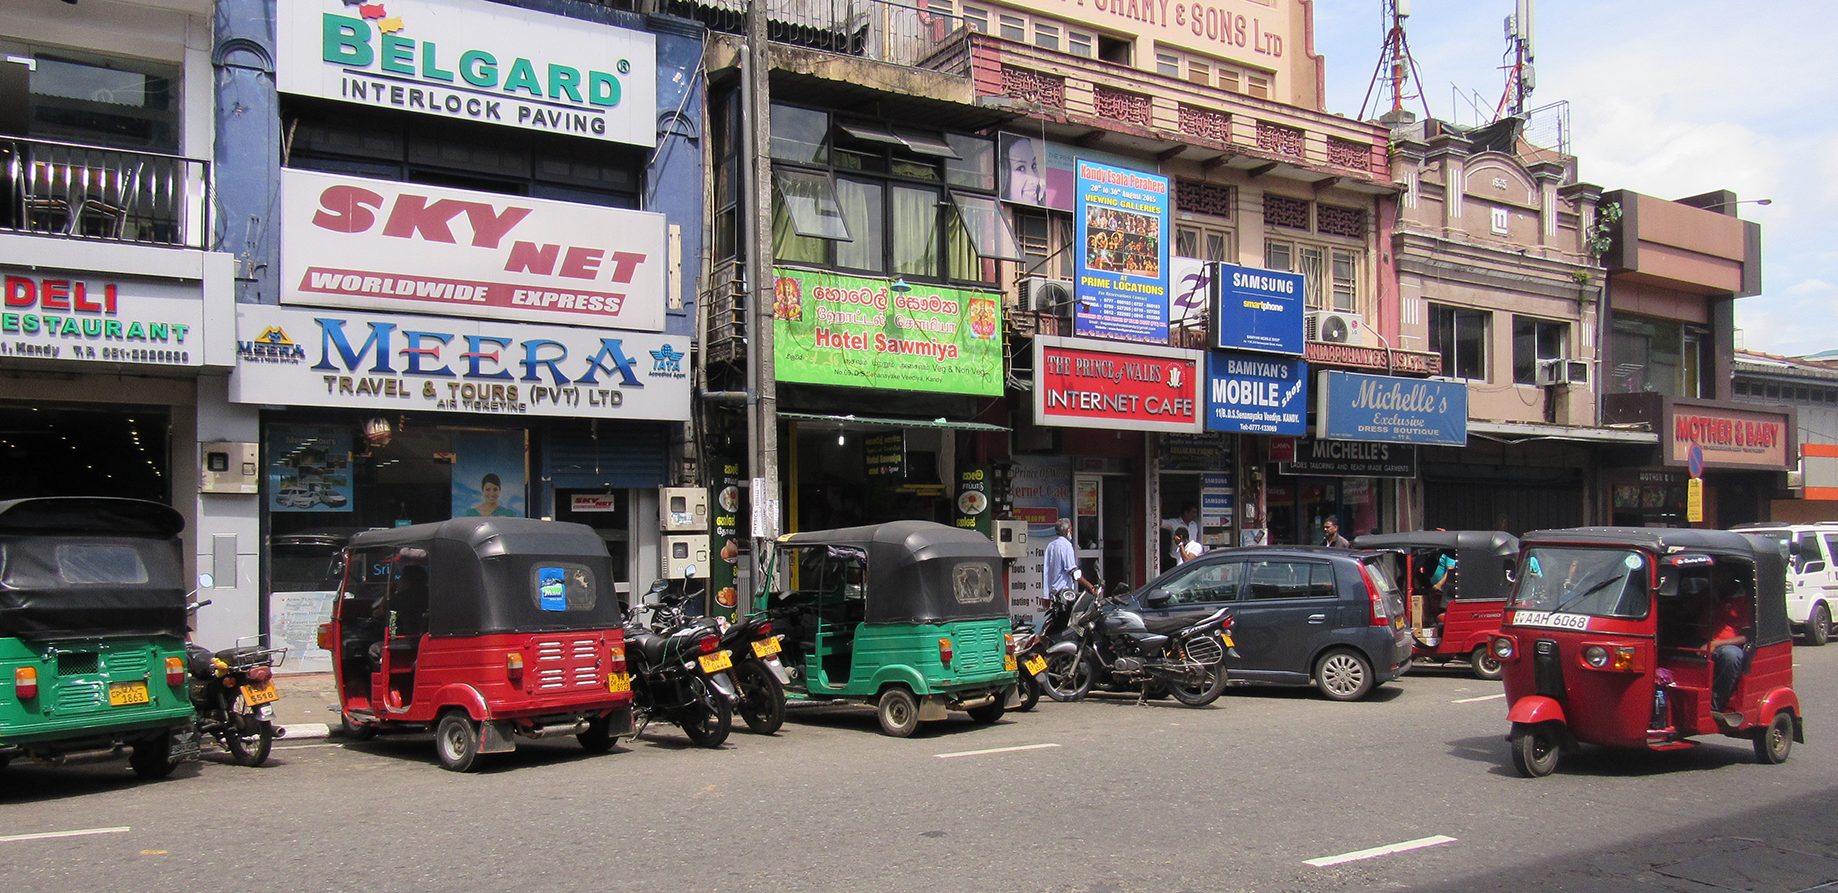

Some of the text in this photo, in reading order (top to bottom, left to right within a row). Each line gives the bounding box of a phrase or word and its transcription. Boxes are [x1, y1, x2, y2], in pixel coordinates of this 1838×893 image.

[1191, 2, 1247, 48] SONS
[323, 12, 622, 107] BELGARD
[342, 77, 606, 134] INTERLOCK PAVING
[1081, 164, 1165, 194] Kandy Esala Perahera
[1085, 194, 1161, 214] VIEWING GALLERIES
[311, 185, 647, 284] SKY NET
[311, 272, 620, 312] WORLDWIDE EXPRESS
[1081, 276, 1164, 296] PRIME LOCATIONS
[1233, 272, 1294, 294] SAMSUNG
[4, 275, 117, 314] DELI
[1243, 300, 1284, 312] smartphone
[16, 342, 60, 357] Kandy
[237, 341, 306, 359] MEERA
[310, 318, 645, 389] MEERA
[815, 327, 959, 362] Hotel Sawmiya
[653, 360, 681, 372] IATA
[932, 364, 946, 374] Veg
[956, 366, 969, 374] Non
[1047, 355, 1162, 384] THE PRINCE of WALES
[1228, 360, 1288, 379] BAMIYAN'S
[323, 375, 623, 408] TRAVEL & TOURS (PVT) LTD
[1047, 389, 1192, 416] INTERNET CAFE
[1212, 378, 1302, 408] MOBILE shop
[1352, 379, 1447, 413] Michelle's
[437, 399, 527, 413] AIR TICKETING
[1358, 425, 1440, 436] DRESS BOUTIQUE
[1373, 412, 1425, 427] Exclusive
[1676, 415, 1779, 448] MOTHER & BABY
[1312, 441, 1389, 460] MICHELLE'S
[373, 563, 390, 576] Sri
[1525, 613, 1586, 628] AAH 6068
[121, 693, 143, 703] 1863
